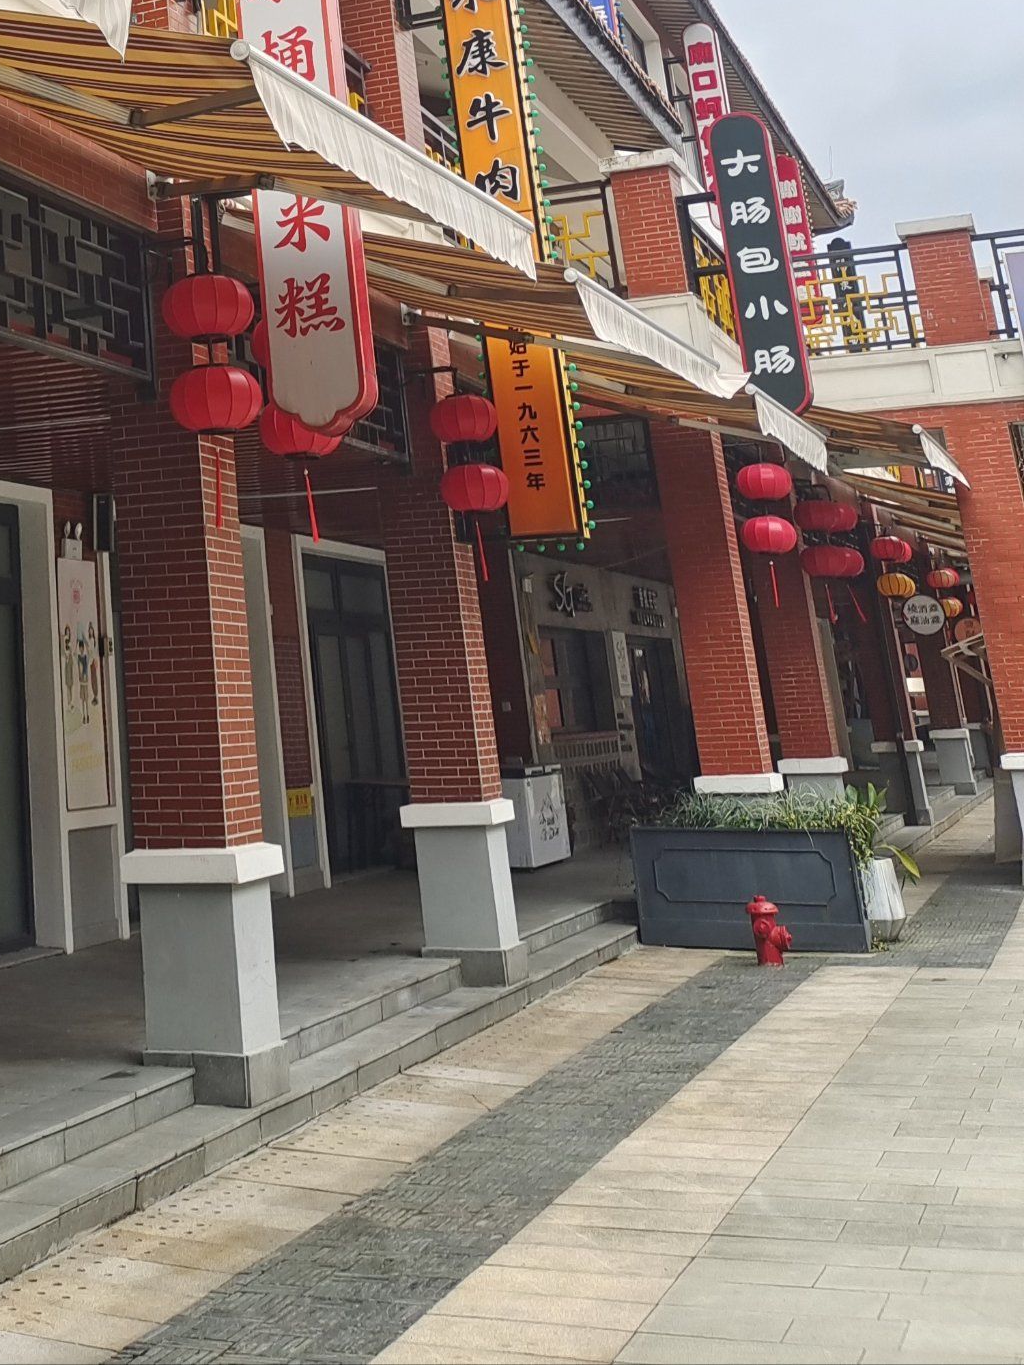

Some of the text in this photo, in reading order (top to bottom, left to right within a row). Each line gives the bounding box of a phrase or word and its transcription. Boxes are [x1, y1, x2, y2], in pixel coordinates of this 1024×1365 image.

[507, 326, 546, 491] 始于一九六三年
